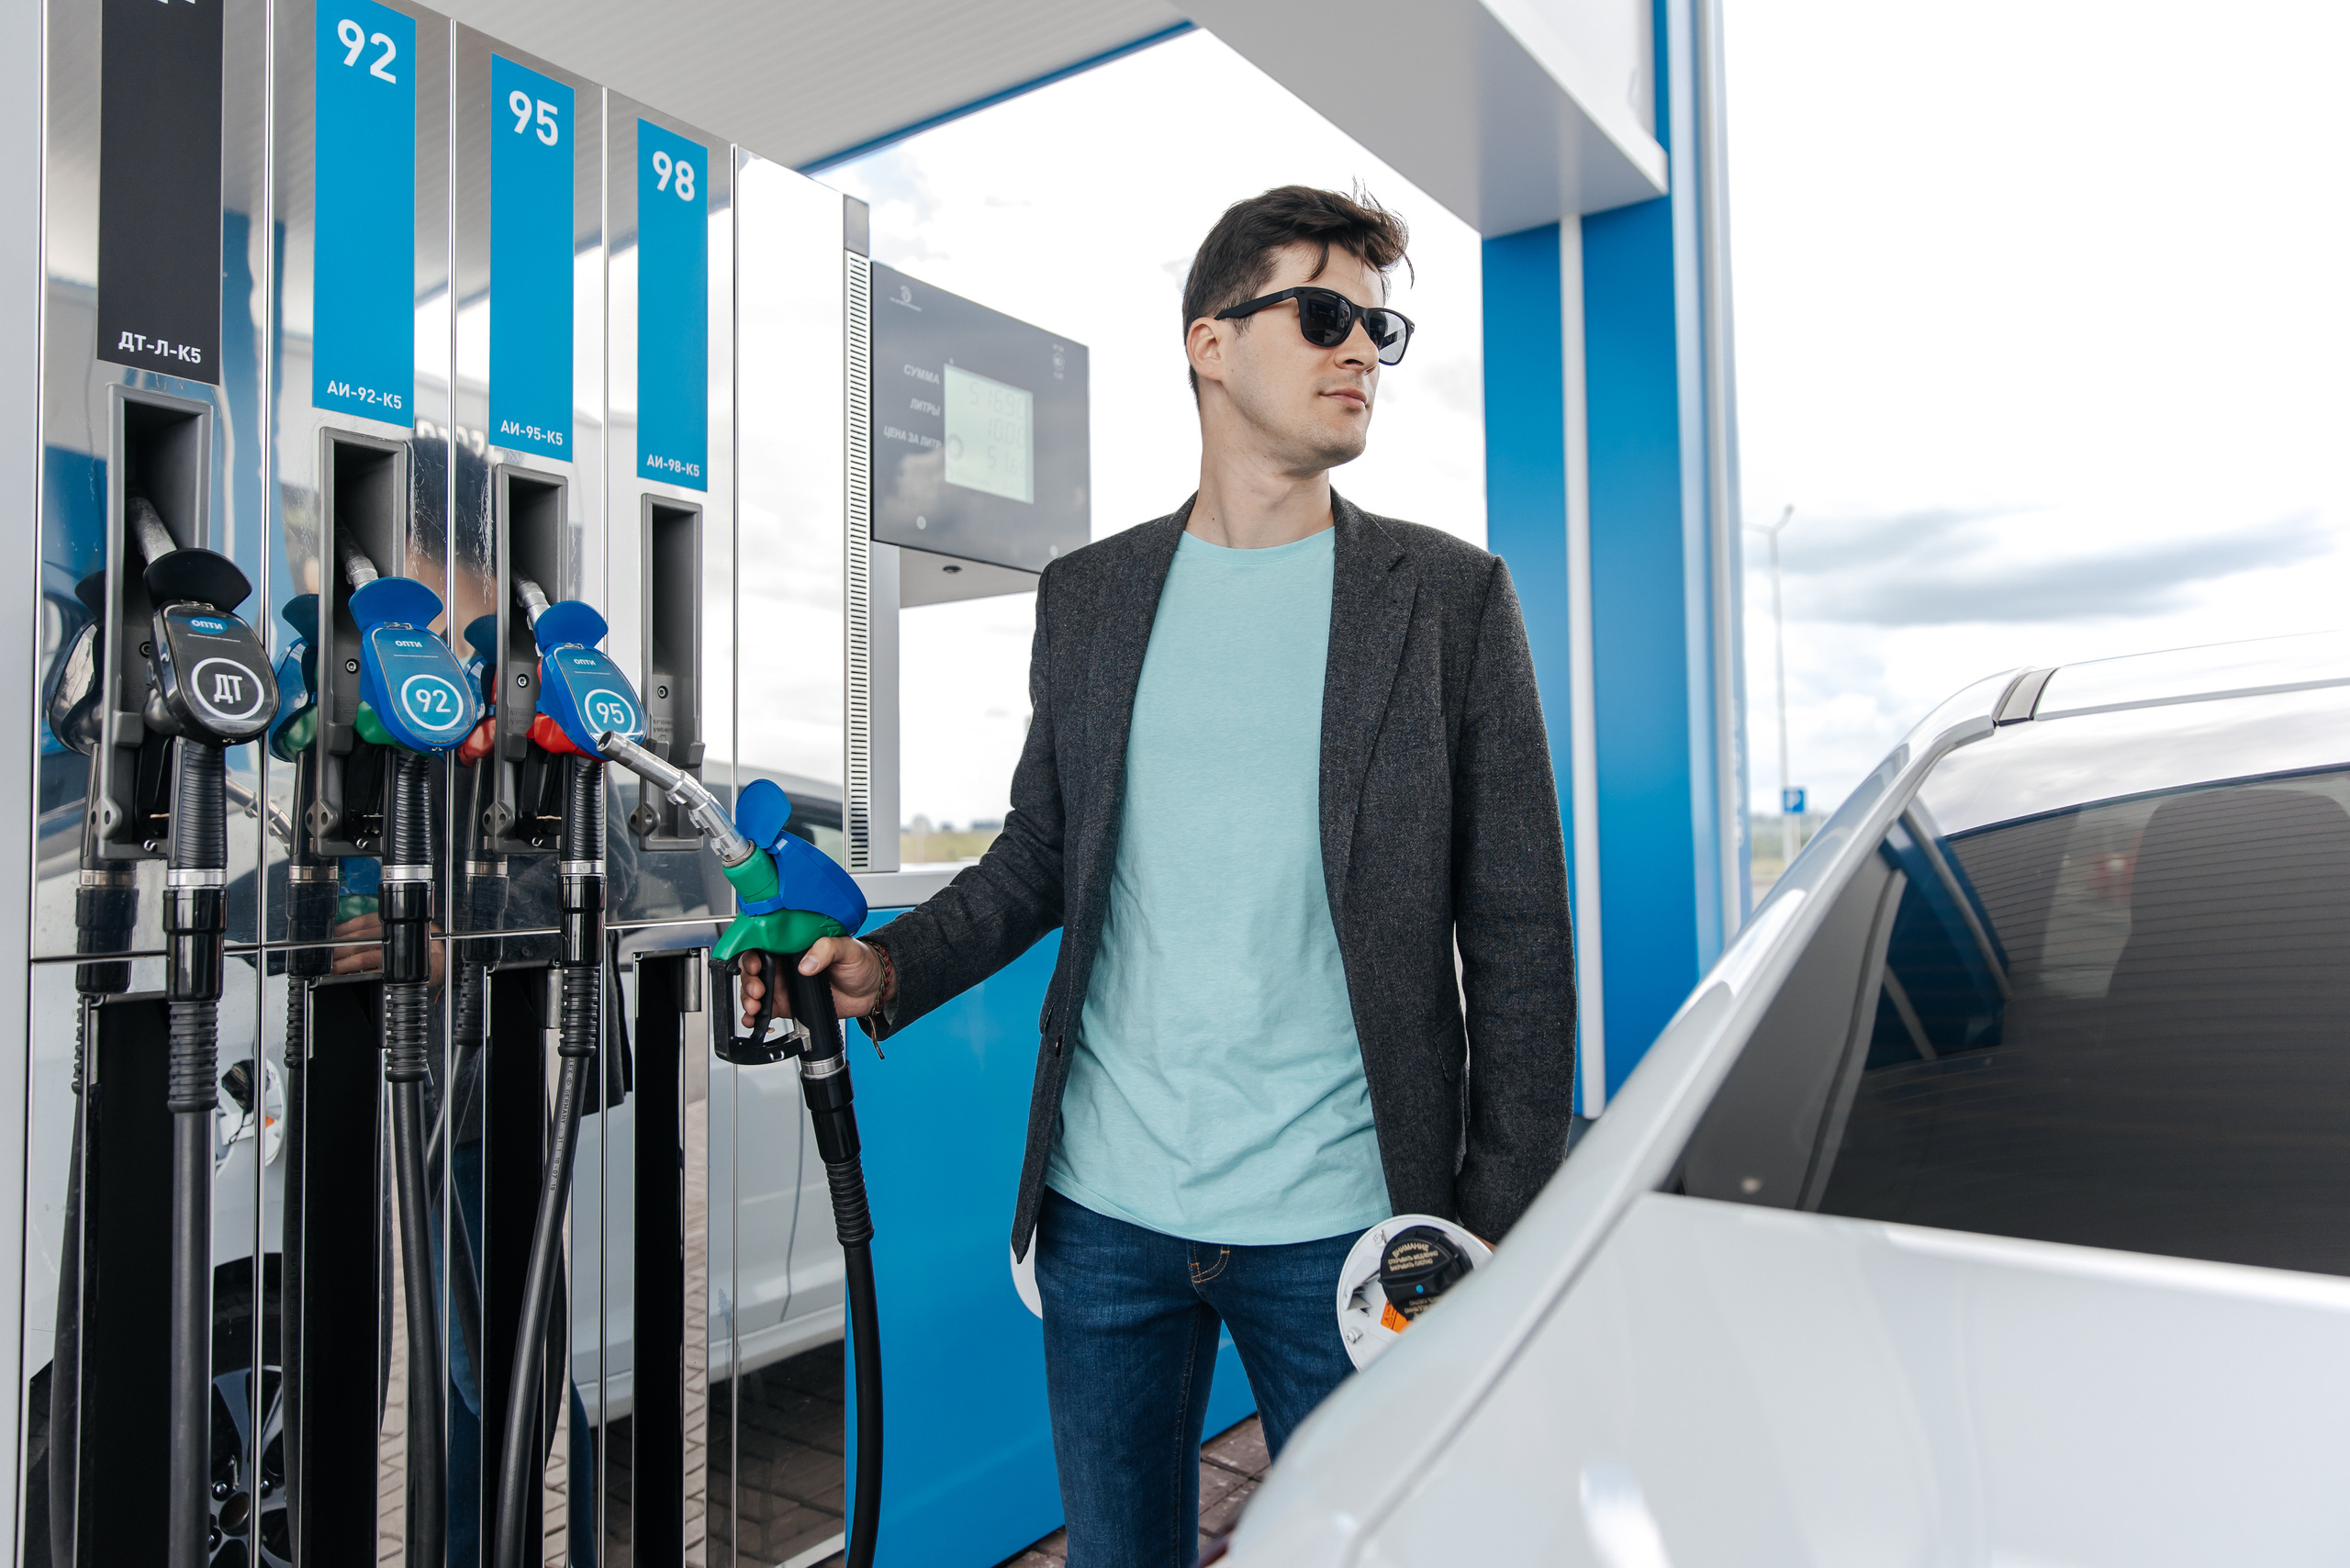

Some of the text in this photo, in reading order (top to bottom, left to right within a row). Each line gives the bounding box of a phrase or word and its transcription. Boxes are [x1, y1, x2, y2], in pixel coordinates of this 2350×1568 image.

[337, 18, 397, 84] 92
[509, 90, 558, 146] 95
[652, 151, 695, 202] 98
[118, 330, 201, 364] ДТ-Л-К5
[903, 364, 940, 385] СУММА
[327, 379, 402, 409] АИ-92-К5
[910, 398, 941, 417] ЛИТРЫ
[500, 420, 563, 446] АИ-95-К5
[883, 425, 942, 449] ЦЕНА ЗА ЛИТР
[646, 454, 699, 477] АИ-98-К5
[213, 673, 242, 704] ДТ
[415, 689, 451, 712] 92
[596, 702, 624, 724] 95
[561, 1089, 571, 1124] GERMANY
[1393, 1243, 1429, 1258] ВНИМАНИЕ
